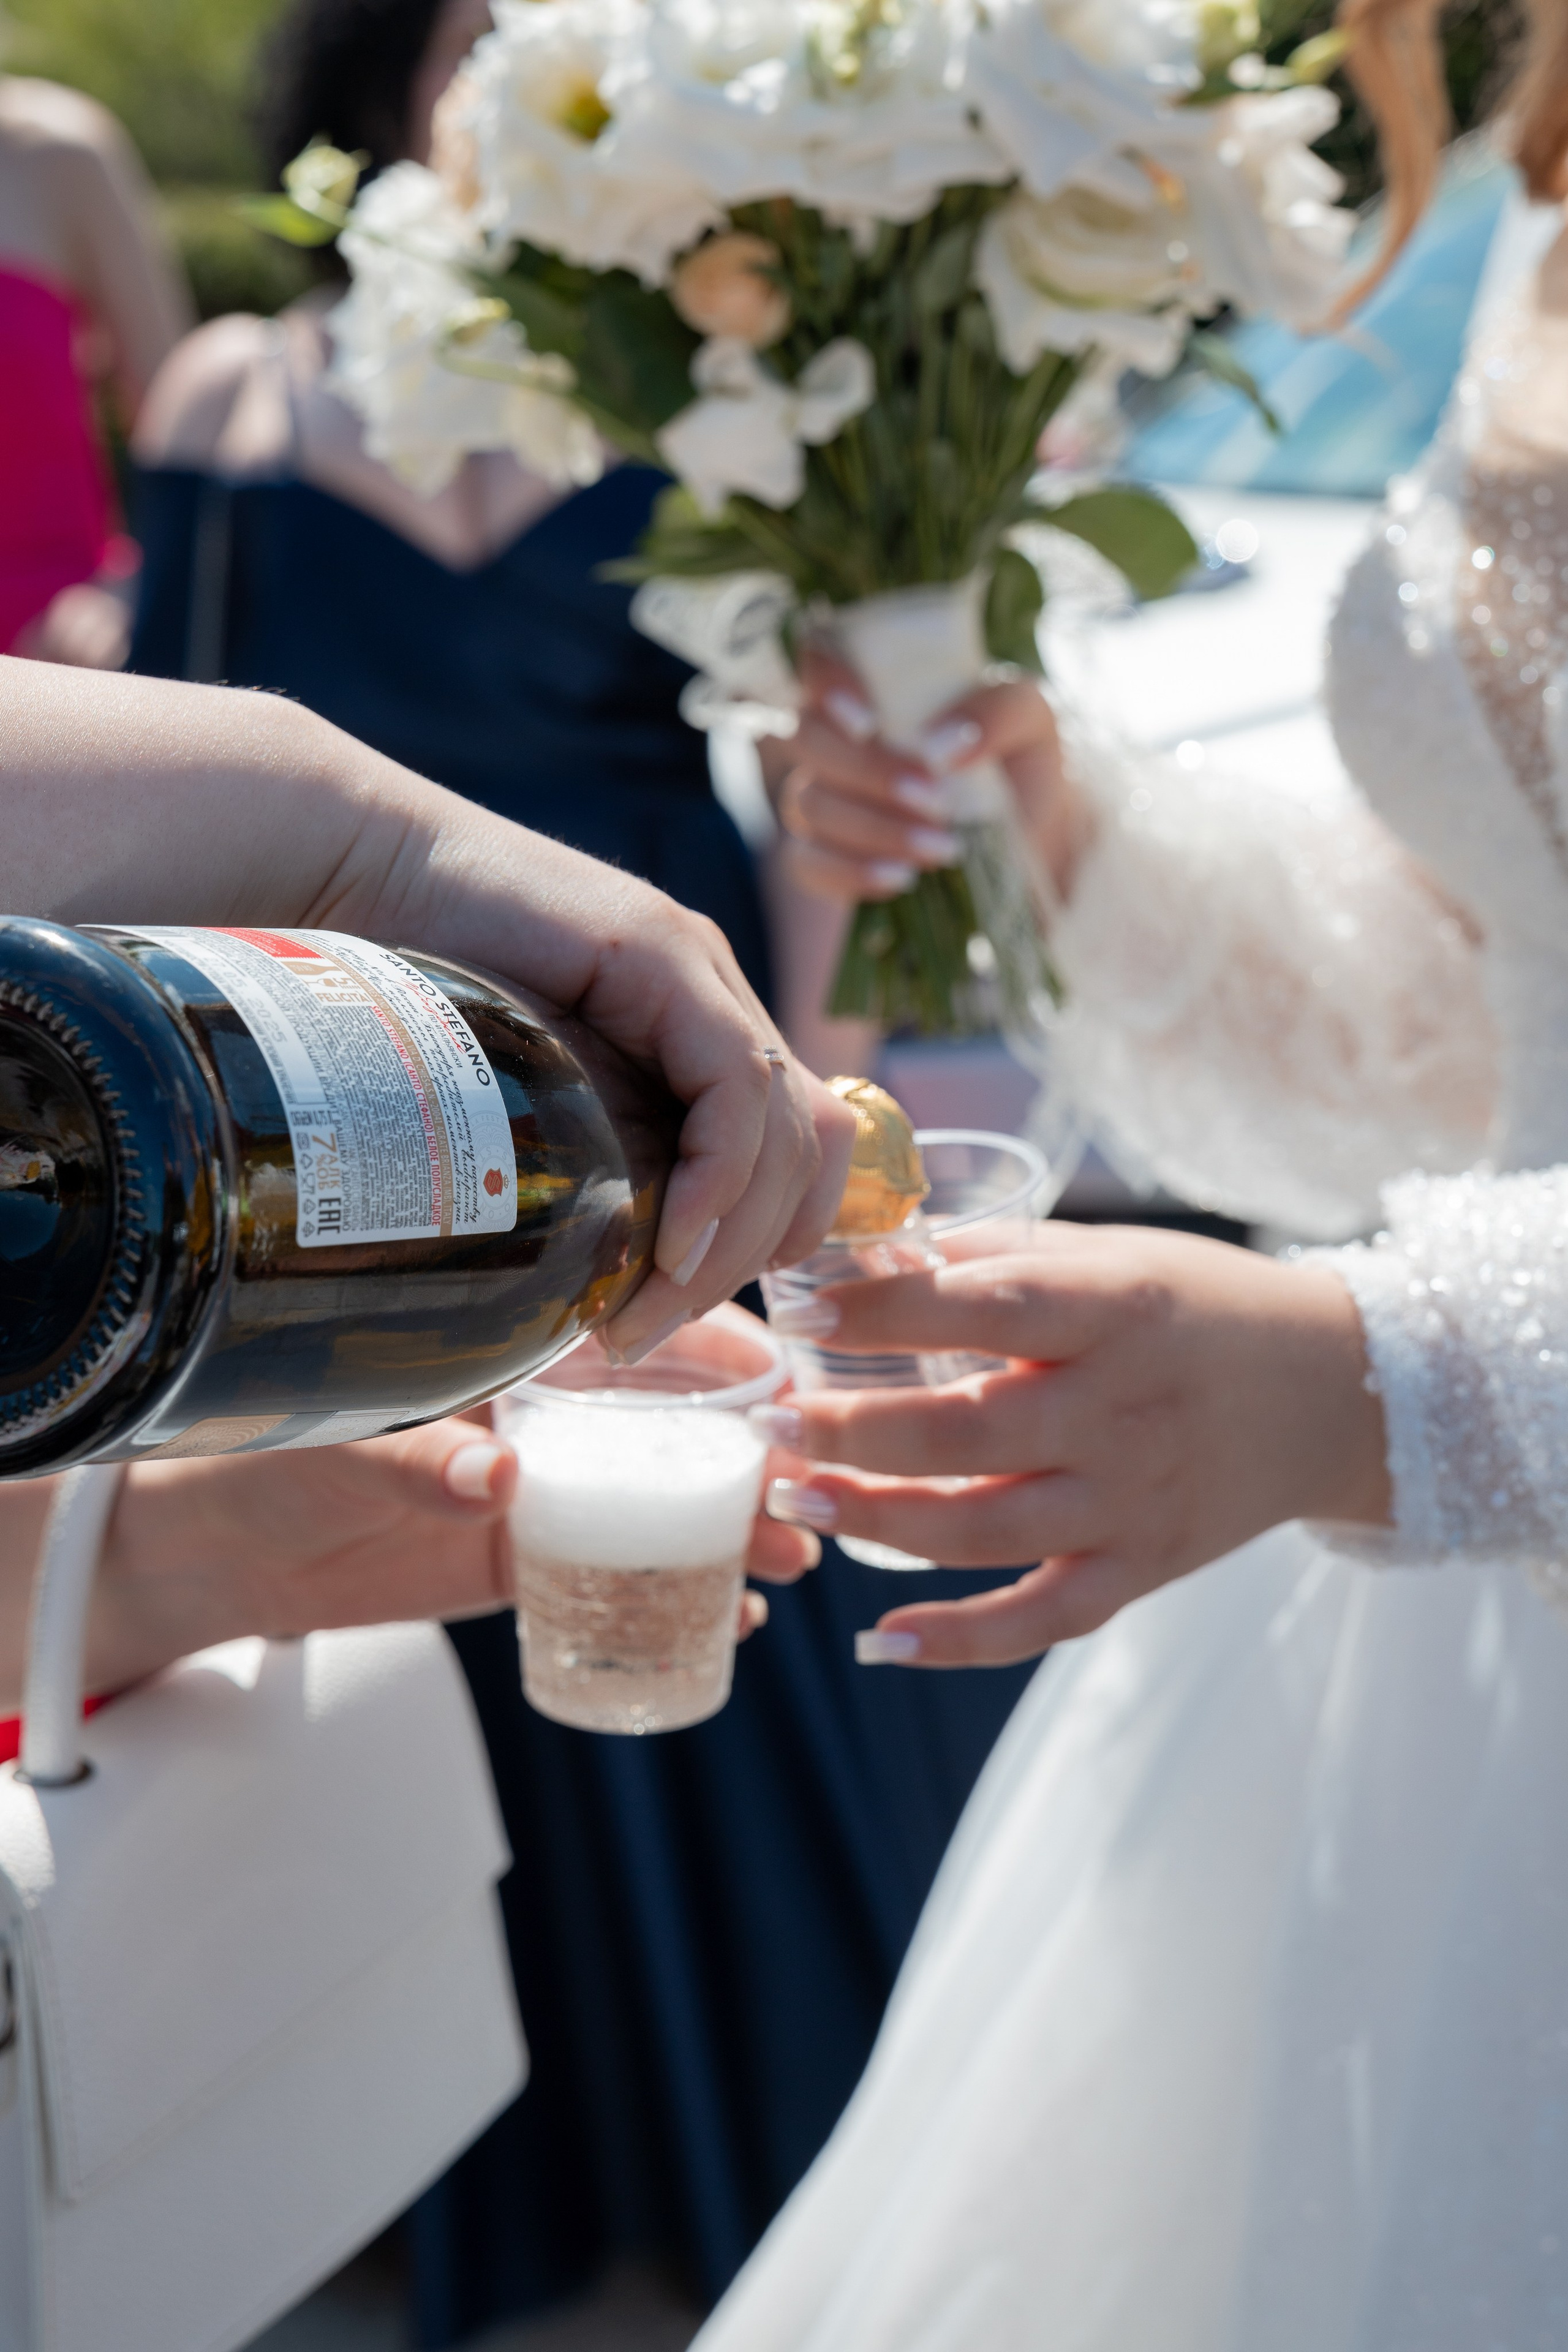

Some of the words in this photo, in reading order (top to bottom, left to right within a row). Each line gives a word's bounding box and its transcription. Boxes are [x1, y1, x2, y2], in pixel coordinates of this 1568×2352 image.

[360, 982, 380, 997] WINES
[374, 998, 390, 1008] AND
[370, 1006, 391, 1026] SANTO
[379, 954, 436, 997] SANTO
[435, 1002, 490, 1086] STEFANO
[384, 1009, 405, 1030] SPIRITS
[396, 978, 466, 1054] Праздник
[386, 1028, 409, 1058] STEFANO
[407, 1045, 418, 1055] VIA
[428, 1014, 462, 1067] ПО-ИТАЛЬЯНСКИ
[404, 1061, 421, 1089] (САНТО
[386, 987, 428, 1041] миллионы
[429, 1049, 465, 1139] потребителей
[461, 1149, 473, 1222] выбирают
[414, 1036, 435, 1072] самых
[429, 1074, 447, 1109] ярких
[445, 1111, 462, 1175] моментов
[416, 1093, 433, 1132] СТЕФАНО)
[286, 1015, 323, 1072] ПРОДУКЦИИ
[333, 1120, 348, 1164] ВАШЕМУ
[341, 1170, 352, 1231] ЗДОРОВЬЮ
[421, 1020, 453, 1076] Благодаря
[451, 1080, 474, 1160] неизменному
[469, 1165, 480, 1222] качеству
[312, 1133, 336, 1152] 7
[427, 1136, 437, 1161] БЕЛОЕ
[437, 1126, 448, 1152] AGRATE
[328, 1155, 339, 1188] АЛК
[441, 1155, 451, 1184] BRIANZA
[430, 1165, 441, 1225] ПОЛУСЛАДКОЕ
[442, 1186, 452, 1203] (MB),
[443, 1205, 451, 1224] ITALY
